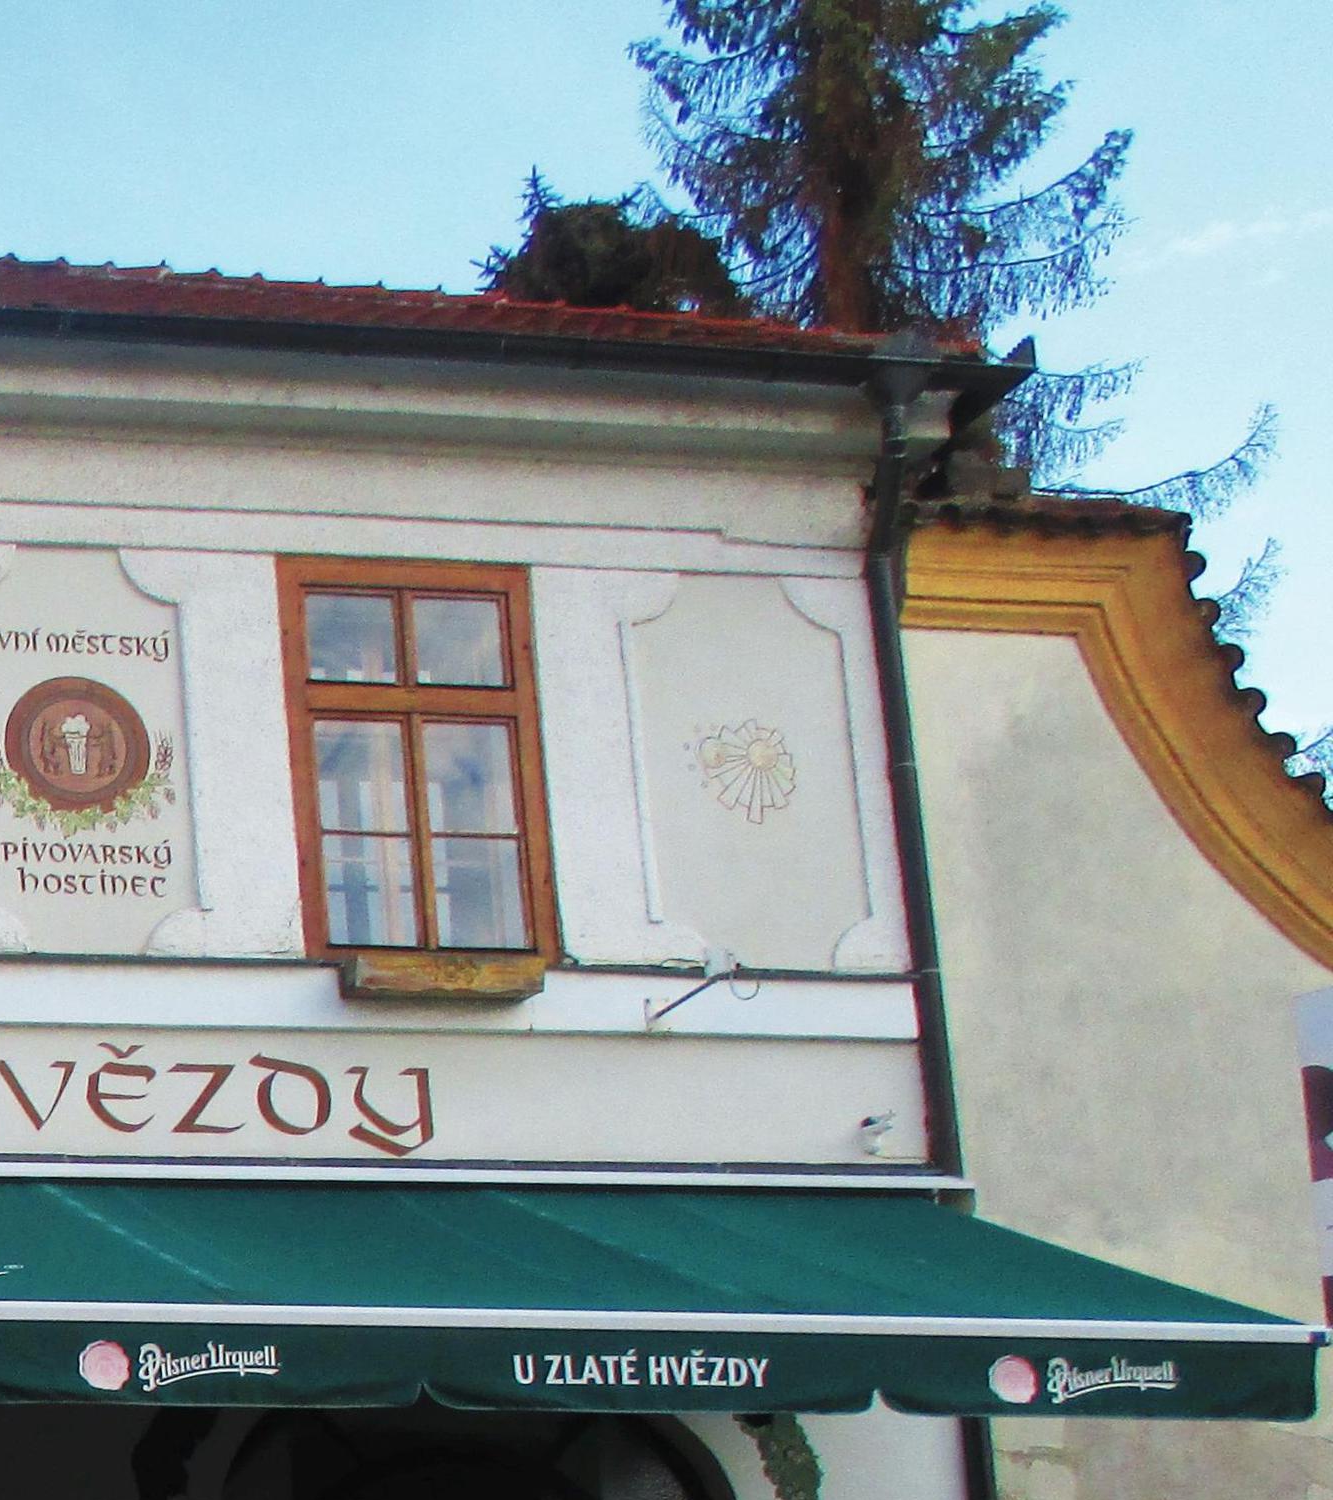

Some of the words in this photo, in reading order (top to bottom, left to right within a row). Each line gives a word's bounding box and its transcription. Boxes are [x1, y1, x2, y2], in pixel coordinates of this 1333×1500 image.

[138, 1342, 210, 1391] Pilsner
[207, 1341, 277, 1376] Urquell
[514, 1355, 536, 1385] U
[545, 1348, 639, 1387] ZLATÉ
[648, 1349, 769, 1388] HVĚZDY
[1048, 1357, 1113, 1403] Pilsner
[1110, 1355, 1176, 1392] Urquell
